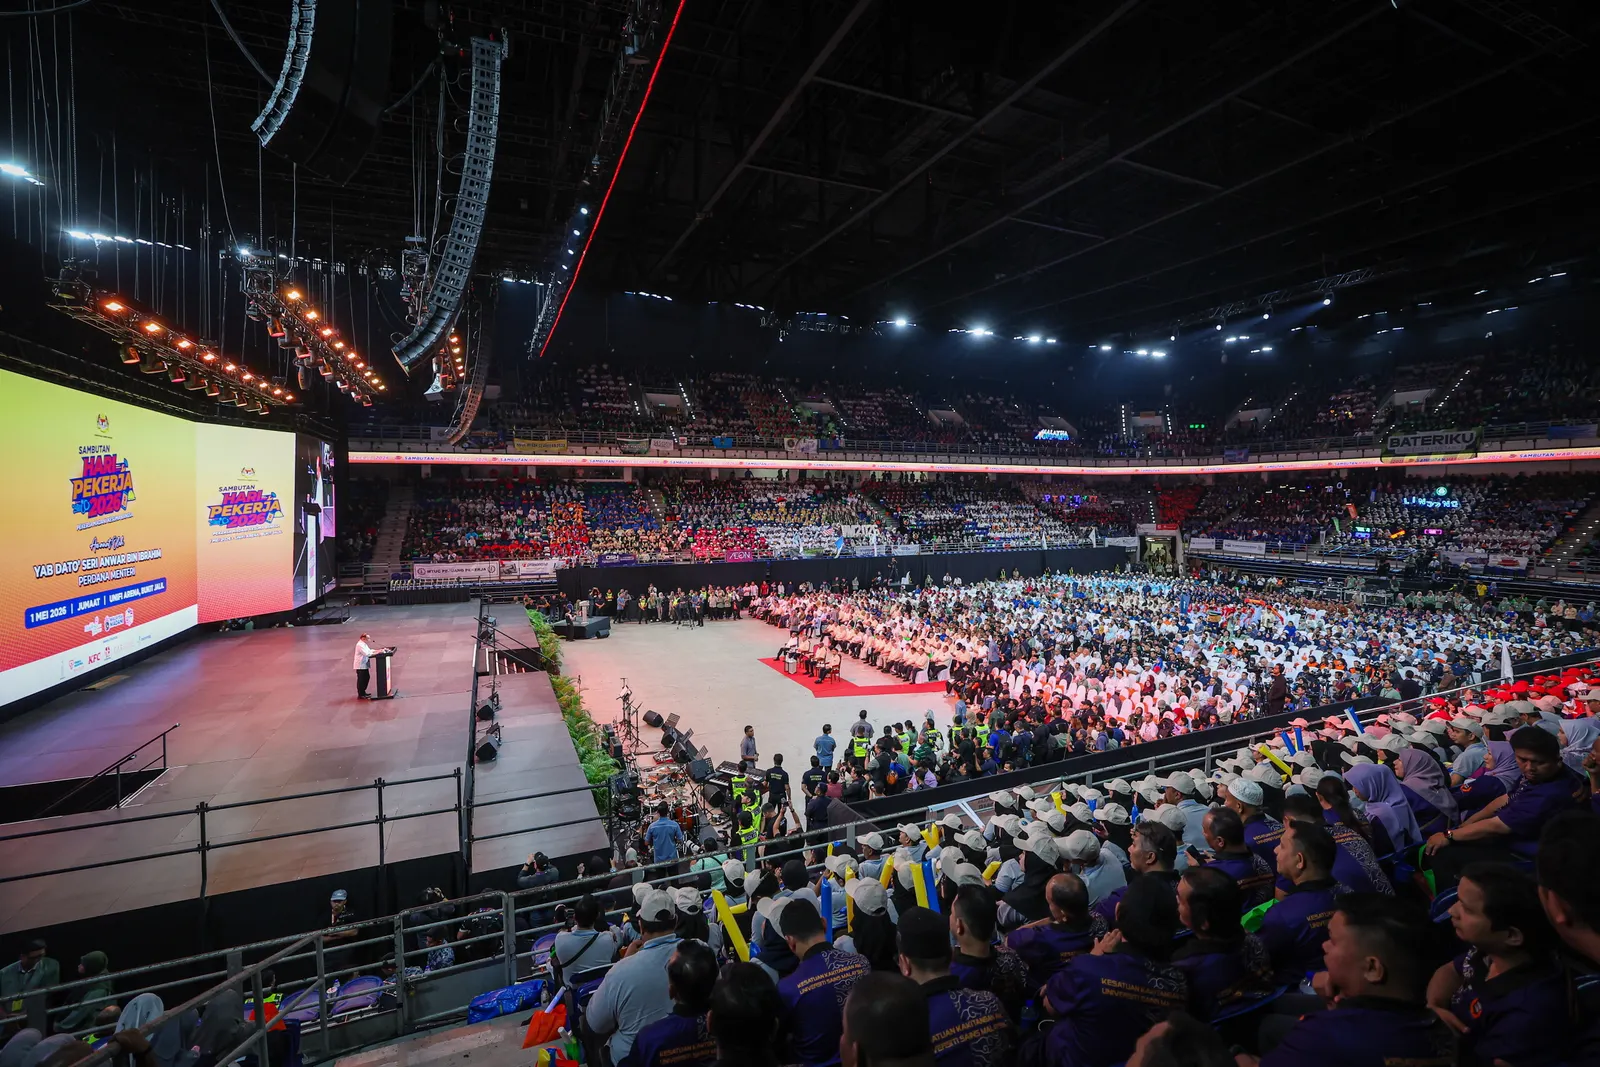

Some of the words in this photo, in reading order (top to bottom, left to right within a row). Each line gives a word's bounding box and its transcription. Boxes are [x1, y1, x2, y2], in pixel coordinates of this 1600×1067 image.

[79, 445, 111, 454] SAMBUTAN
[1390, 433, 1474, 448] BATERIKU
[82, 454, 117, 477] HARI
[71, 472, 133, 500] PEKERJA
[88, 492, 123, 518] 2026
[222, 490, 263, 505] HARI
[208, 500, 281, 518] PEKERJA
[226, 512, 267, 528] 2026
[33, 565, 54, 579] YAB
[55, 561, 81, 575] DATO'
[82, 557, 99, 571] SERI
[99, 555, 126, 569] ANWAR
[127, 552, 139, 564] BIN
[138, 548, 162, 562] IBRAHIM
[78, 571, 111, 587] PERDANA
[110, 567, 136, 581] MENTERI
[30, 613, 35, 623] 1
[36, 610, 49, 621] MEI
[49, 606, 67, 619] 2026
[77, 597, 101, 611] JUMAAT
[109, 593, 124, 603] UNIFI
[88, 652, 101, 665] KFC
[797, 974, 825, 988] KESATUAN
[824, 964, 855, 977] KAKITANGAN
[1101, 978, 1140, 992] KESATUAN
[800, 980, 827, 994] UNIVERSITI
[1102, 988, 1141, 1001] UNIVERSITI
[932, 1026, 957, 1043] ATUAN
[956, 1014, 994, 1032] KAKITANGAN
